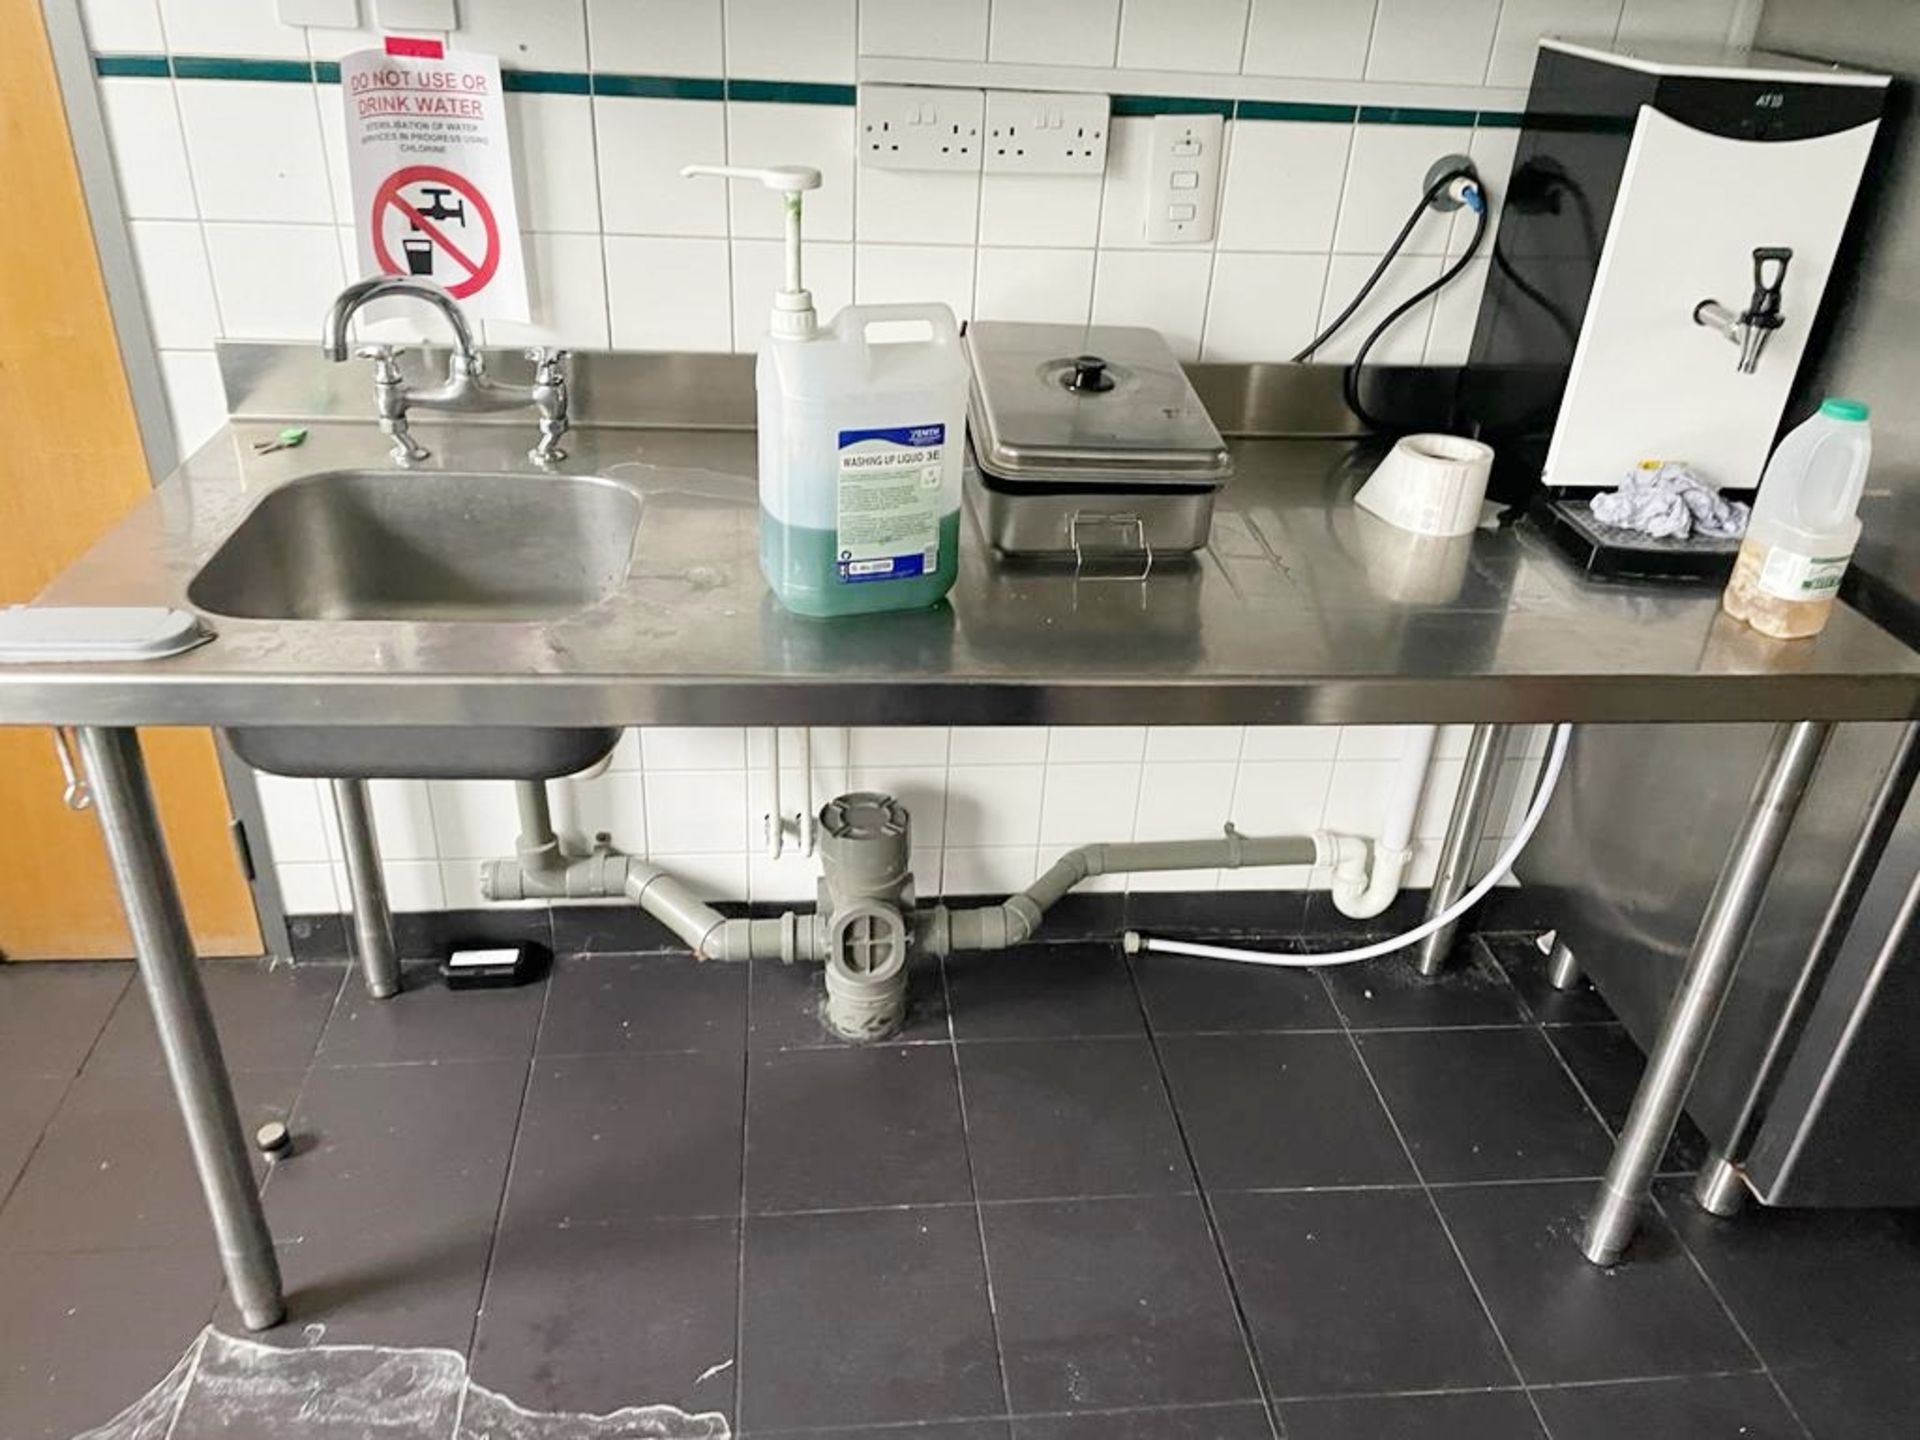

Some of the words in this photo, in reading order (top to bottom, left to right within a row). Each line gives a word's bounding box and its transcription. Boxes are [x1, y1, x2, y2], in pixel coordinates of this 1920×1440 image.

[351, 72, 369, 91] DO
[373, 70, 410, 87] NOT
[418, 72, 457, 89] USE
[462, 74, 487, 90] OR
[358, 96, 410, 115] DRINK
[416, 97, 483, 115] WATER
[447, 122, 478, 131] WATER
[844, 455, 882, 467] WASHING
[884, 455, 895, 465] UP
[897, 452, 925, 465] LIQUID
